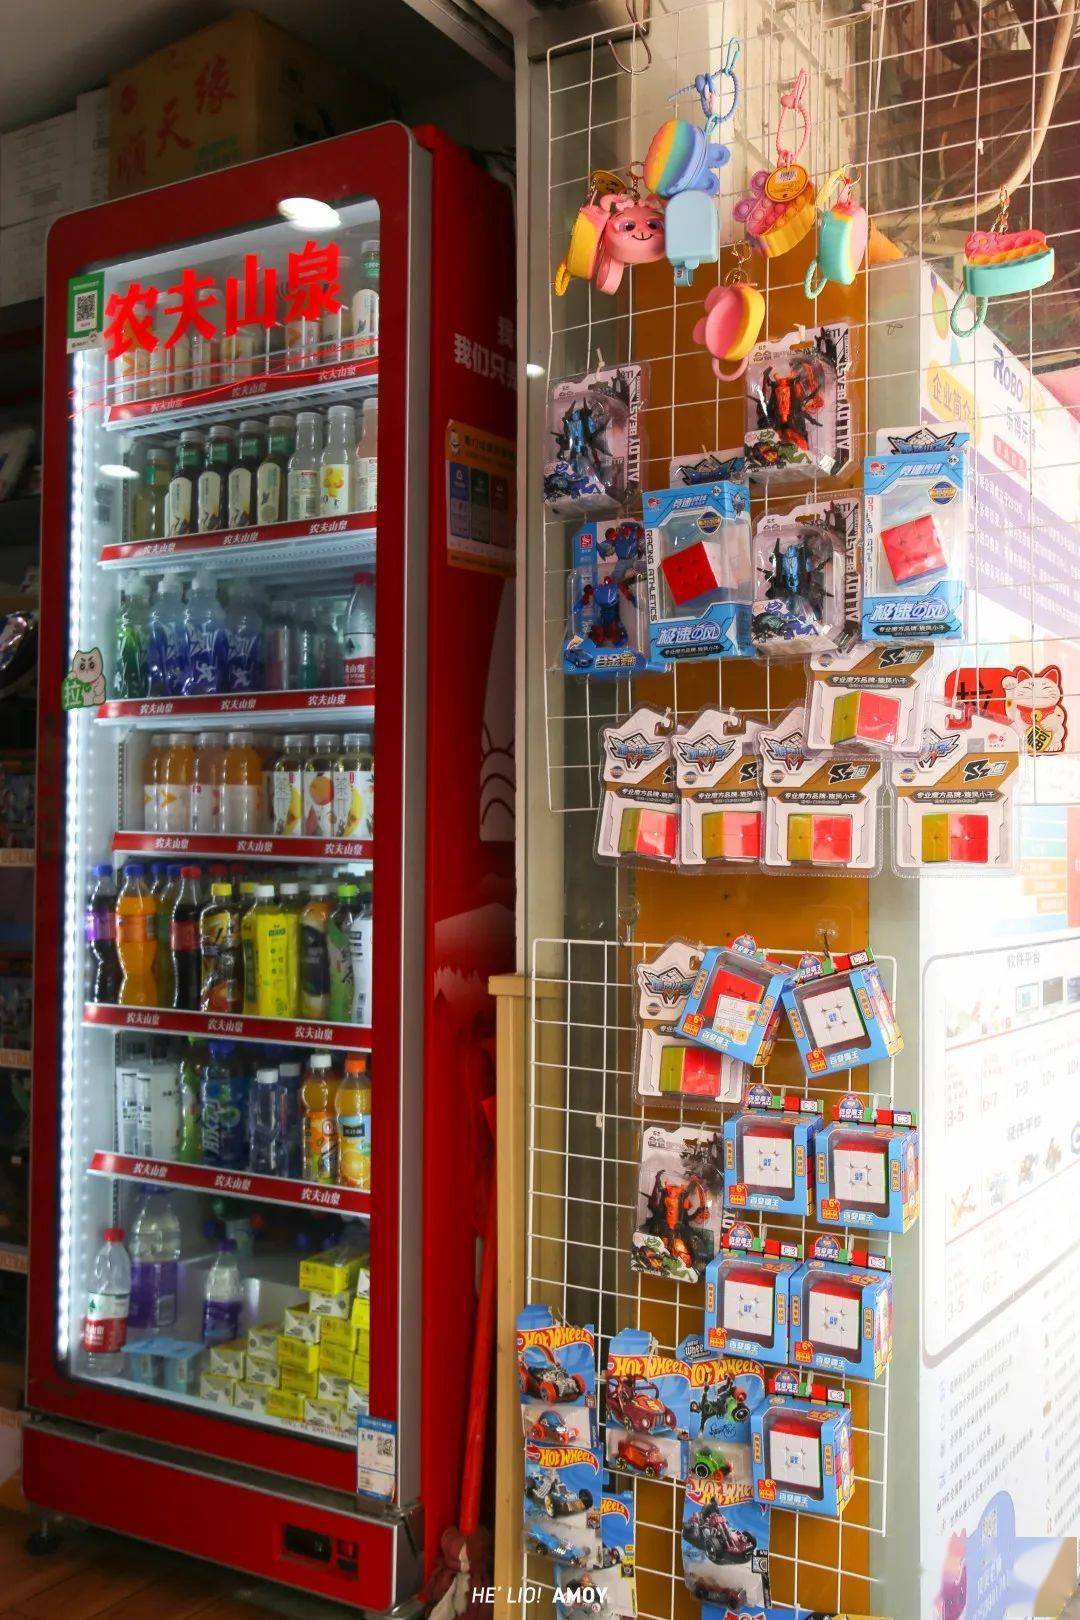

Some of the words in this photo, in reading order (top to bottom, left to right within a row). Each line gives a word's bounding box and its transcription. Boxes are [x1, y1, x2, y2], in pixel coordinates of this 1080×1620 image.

[103, 240, 342, 362] 农夫山泉
[992, 342, 1024, 402] ROBO
[932, 371, 973, 421] 企业简介
[310, 520, 348, 534] 农夫山泉
[223, 532, 259, 546] 农夫山泉
[143, 543, 175, 554] 农夫山泉
[646, 529, 654, 564] RACING
[648, 566, 658, 622] ATHLETICS
[869, 598, 949, 623] 极速の风
[656, 621, 721, 647] 极速の风
[831, 675, 908, 685] 专业魔方品牌·旋风小子
[65, 683, 80, 706] 拉
[308, 694, 347, 707] 农夫山泉
[140, 703, 173, 716] 农夫山泉
[220, 699, 257, 711] 农夫山泉
[916, 791, 995, 800] 专业魔方品牌·旋风小子
[155, 838, 190, 850] 农夫山泉
[237, 841, 273, 853] 农夫山泉
[324, 843, 363, 856] 农夫山泉
[1006, 950, 1041, 970] 软件平台
[126, 1012, 160, 1026] 农夫山泉
[208, 1019, 244, 1033] 农夫山泉
[294, 1026, 334, 1041] 农夫山泉
[133, 1162, 168, 1178] 农夫山泉
[214, 1175, 251, 1191] 农夫山泉
[301, 1187, 341, 1206] 农夫山泉
